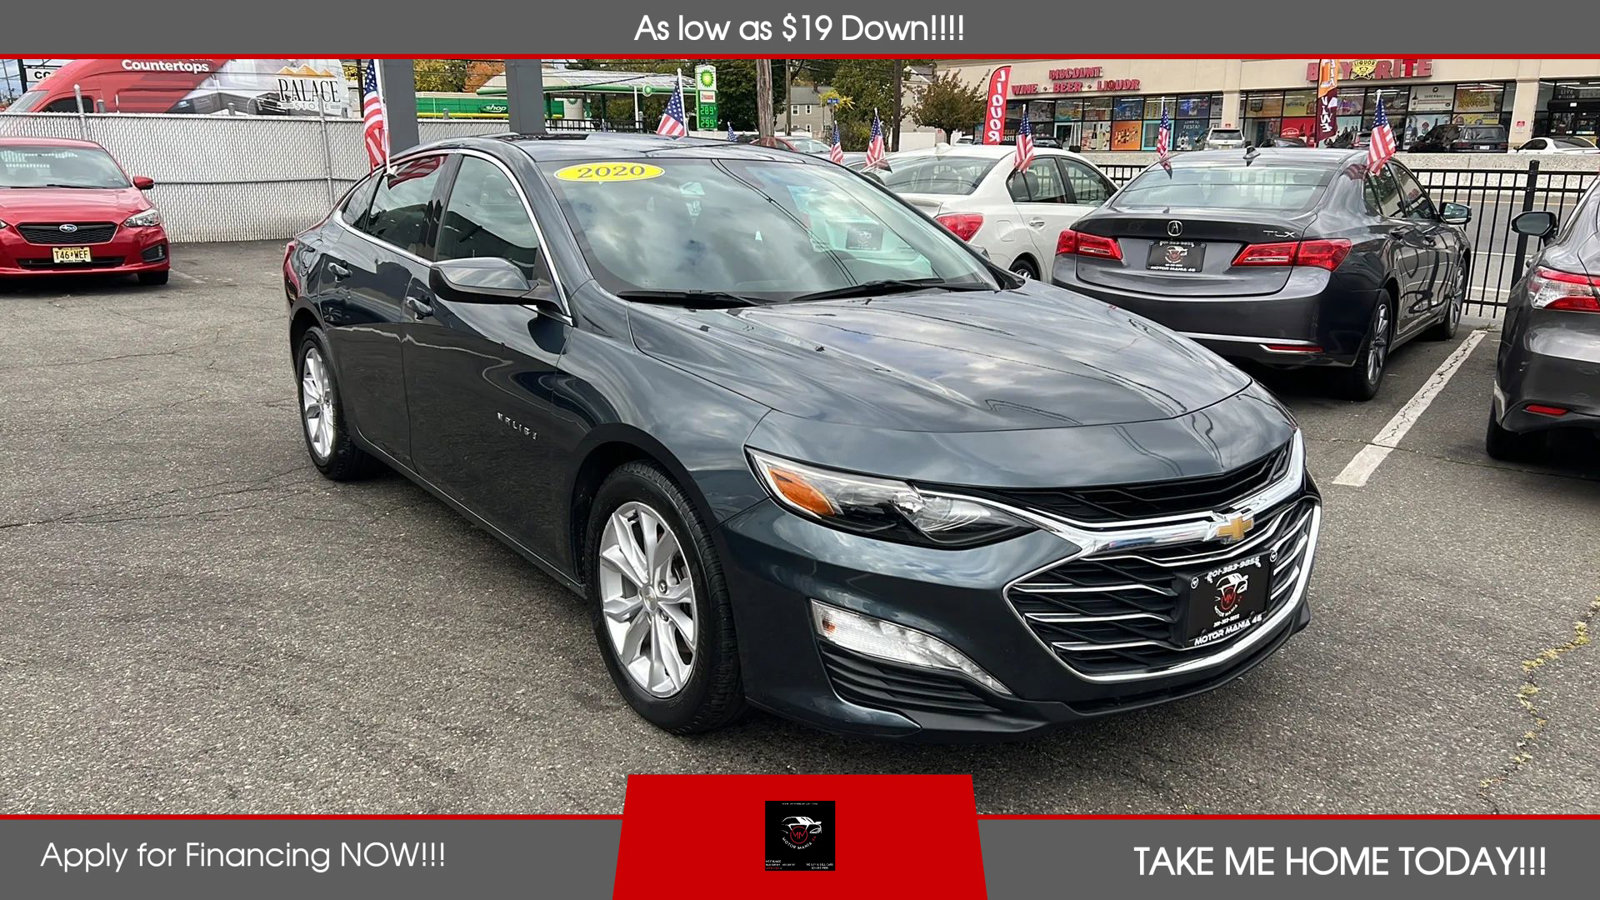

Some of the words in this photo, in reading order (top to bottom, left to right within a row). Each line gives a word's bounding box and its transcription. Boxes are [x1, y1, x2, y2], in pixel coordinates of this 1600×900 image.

[122, 59, 209, 74] Countertops
[1375, 59, 1432, 79] RITE
[278, 78, 341, 103] PALACE
[1011, 83, 1039, 96] WINE
[1052, 81, 1083, 93] BEER
[577, 164, 646, 180] 2020
[1262, 229, 1296, 239] TLX
[1194, 629, 1225, 646] MOTOR
[1225, 619, 1251, 635] MANIA
